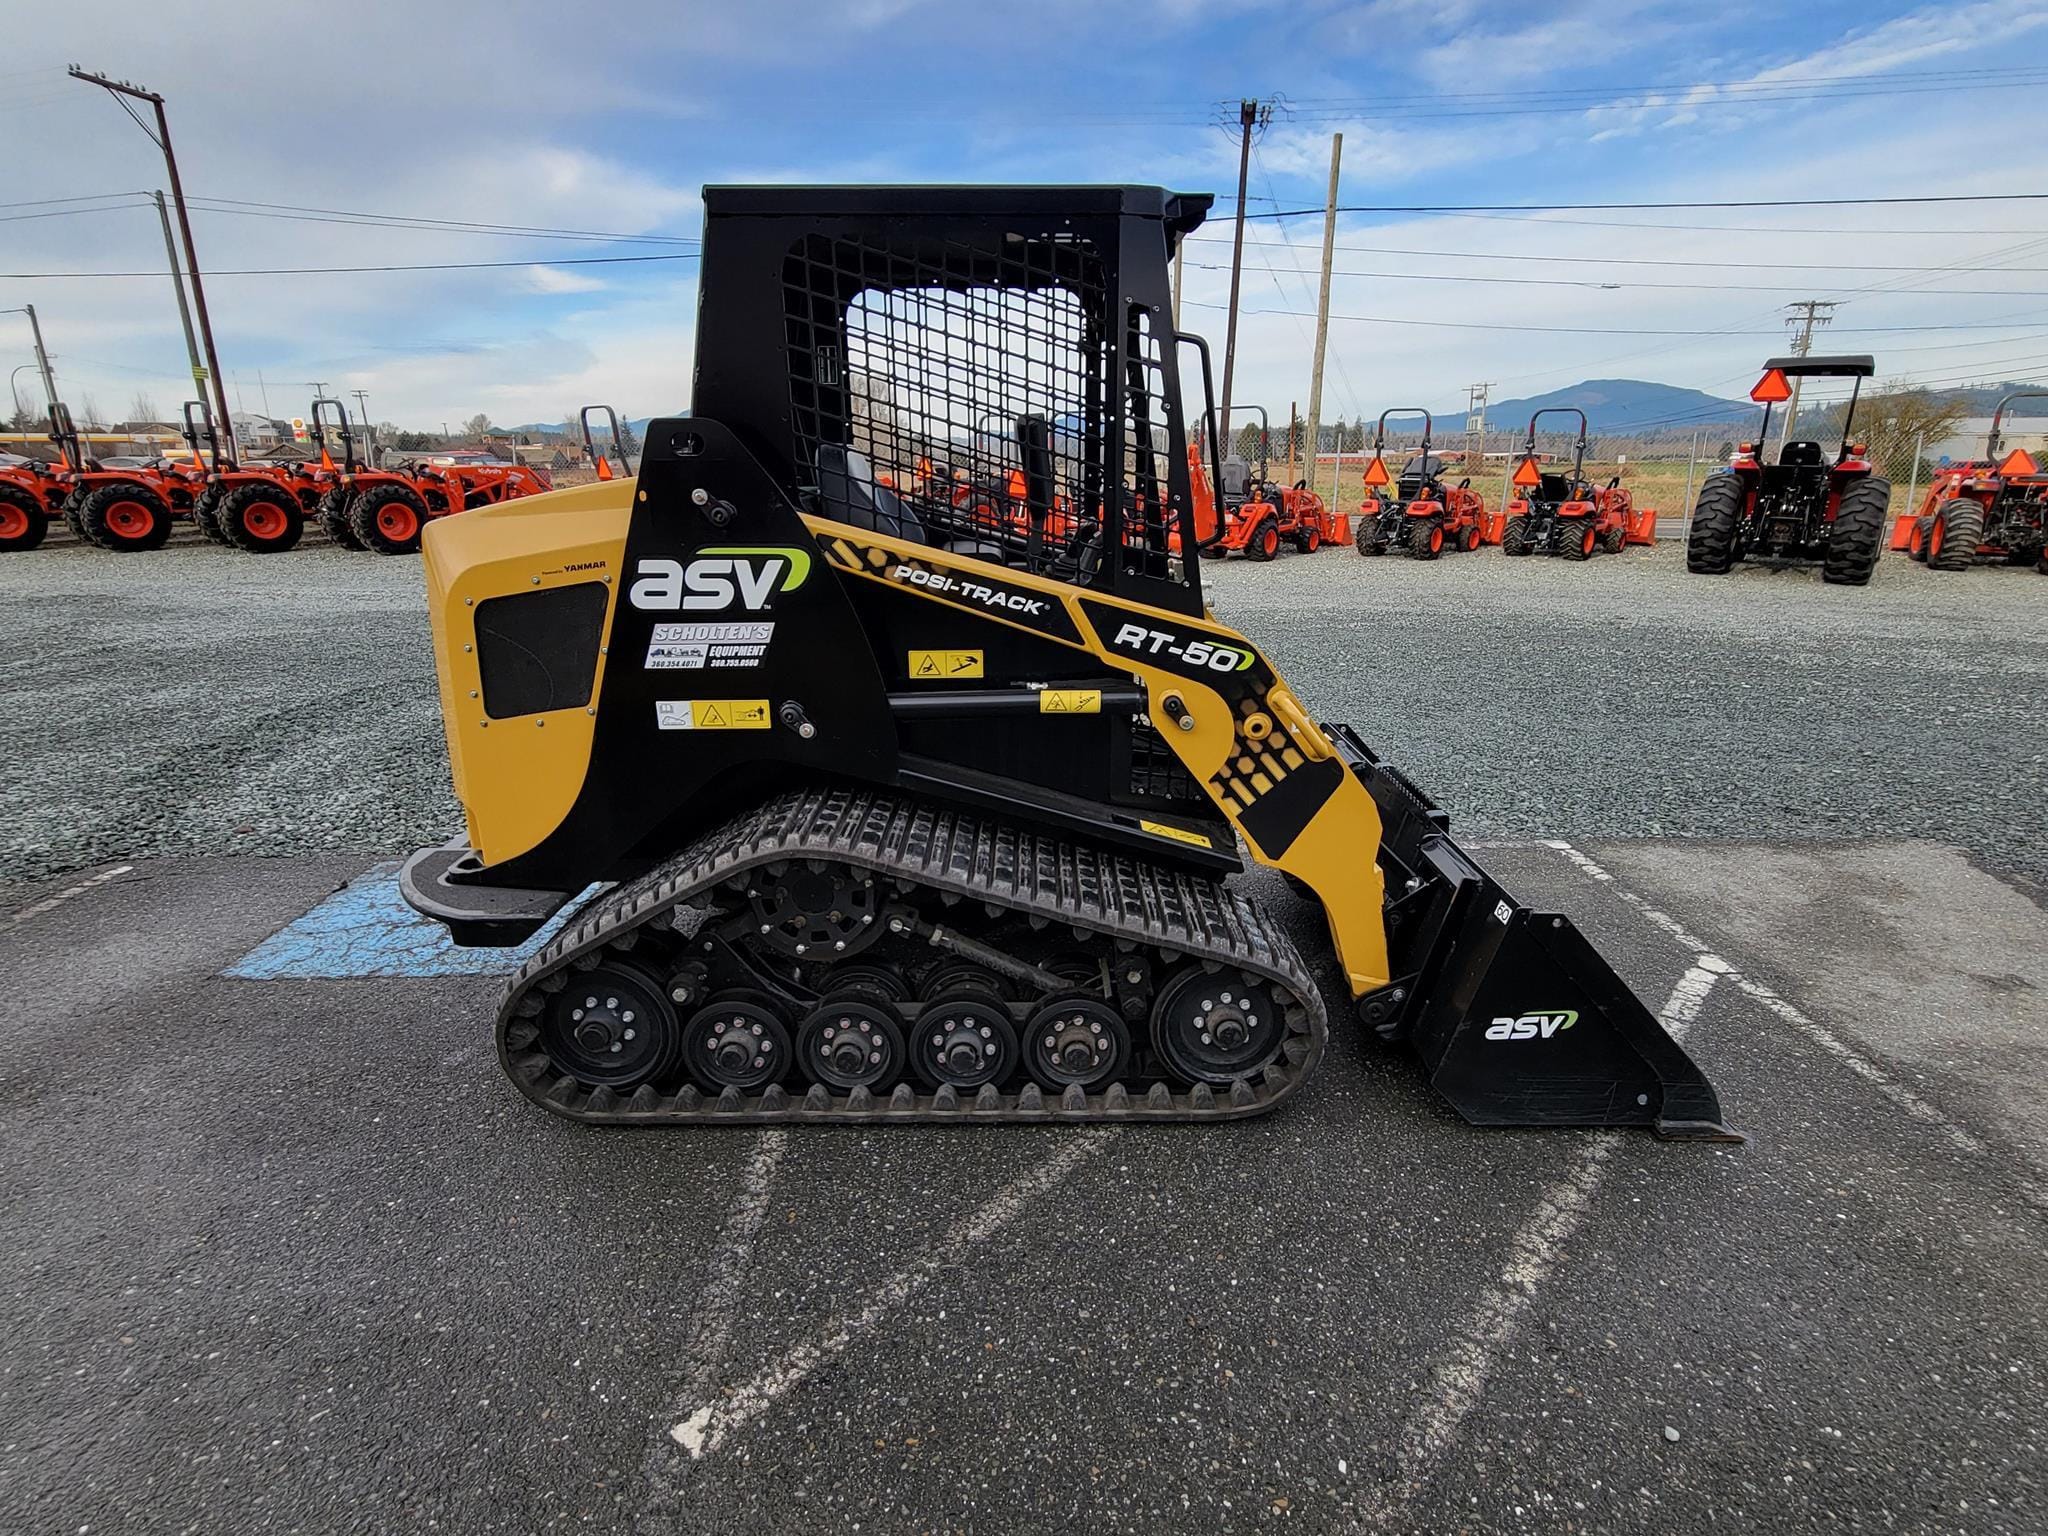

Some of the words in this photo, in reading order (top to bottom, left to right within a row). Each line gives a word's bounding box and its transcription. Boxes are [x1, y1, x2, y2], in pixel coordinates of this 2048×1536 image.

[564, 561, 606, 572] YANMAR
[655, 625, 769, 641] SCHOLTEN'S
[708, 645, 767, 657] EQUIPMENT
[1114, 623, 1239, 672] RT-50
[1497, 904, 1510, 920] 60
